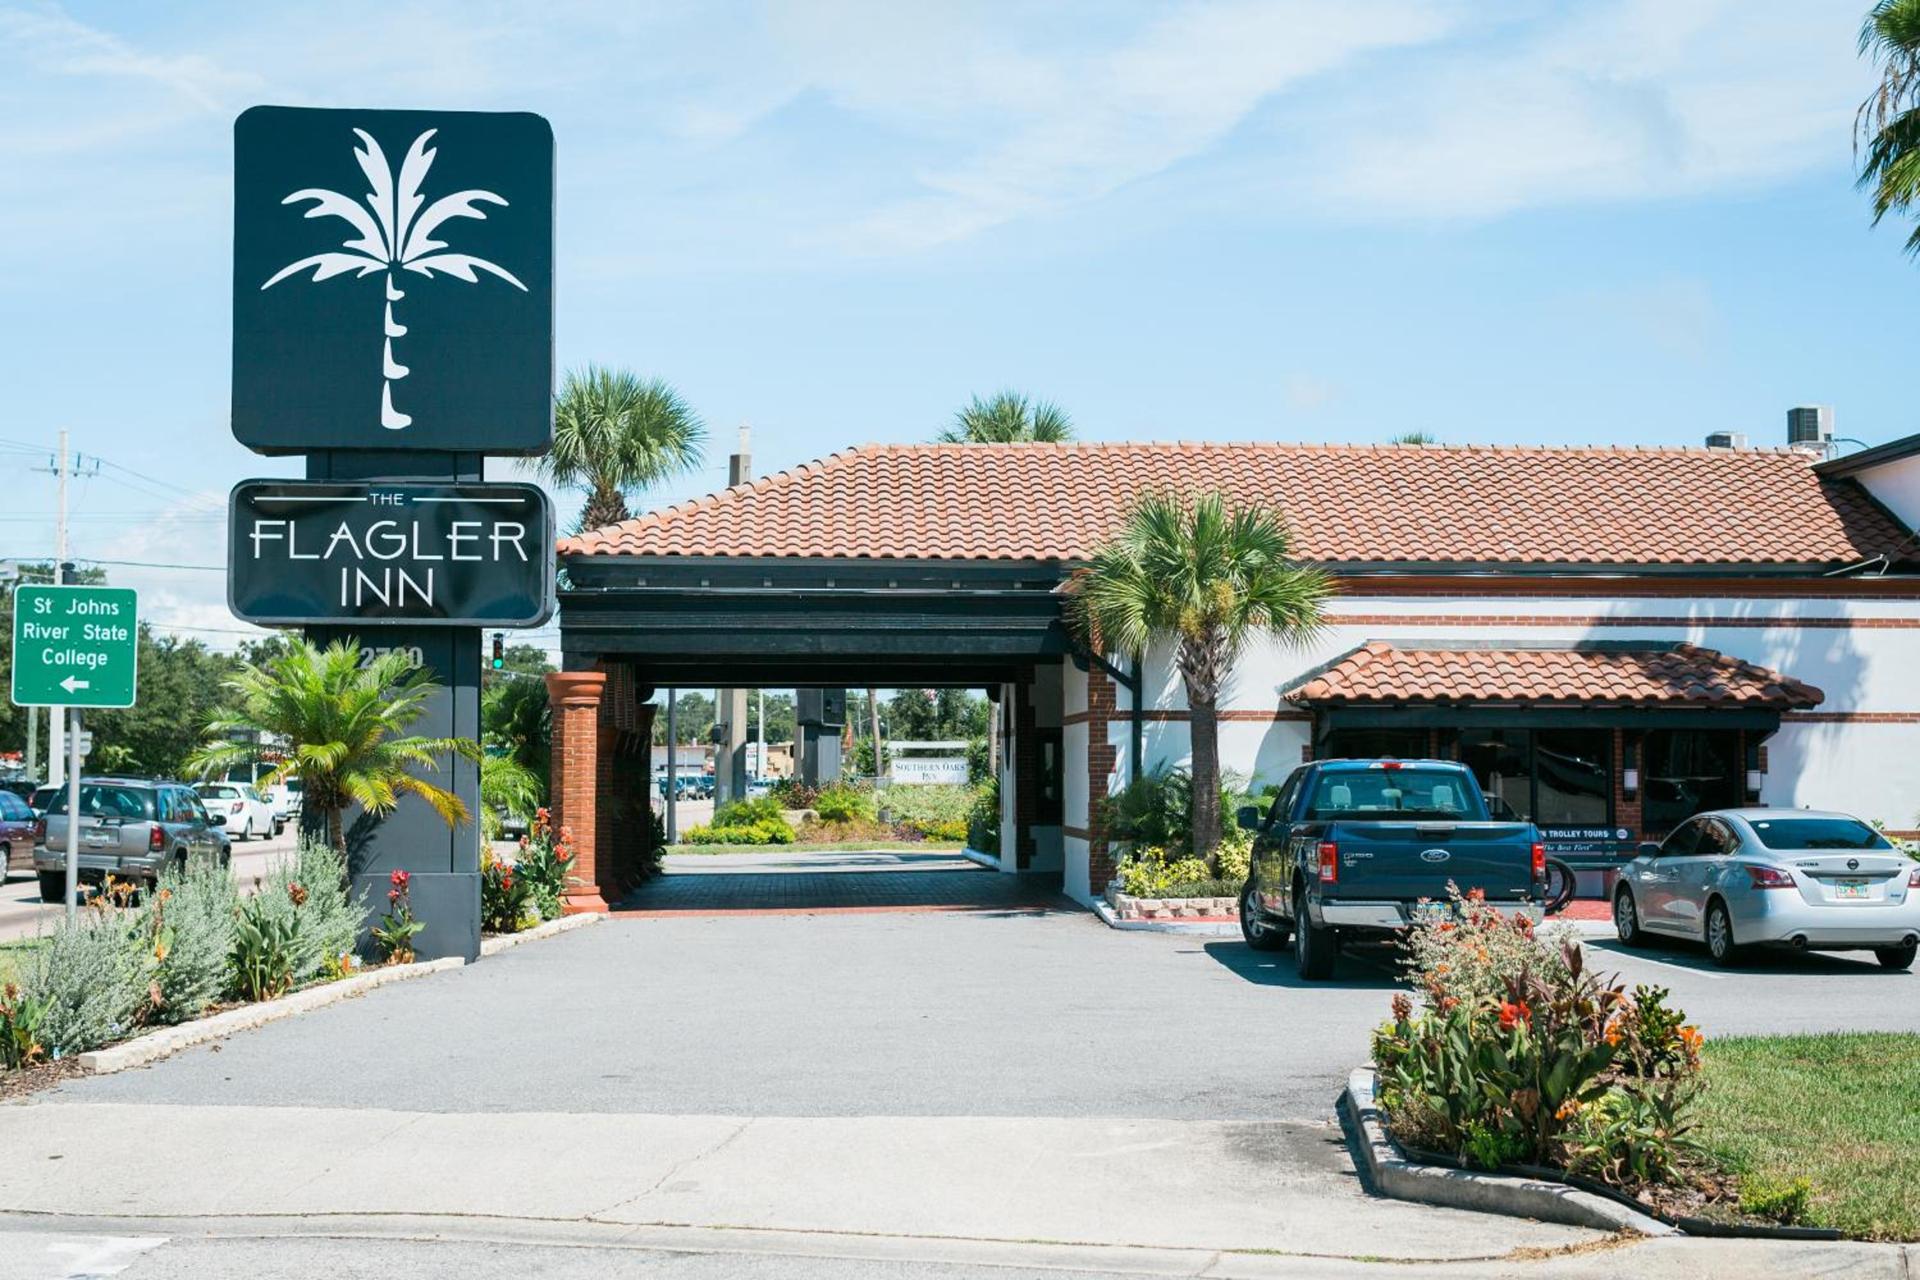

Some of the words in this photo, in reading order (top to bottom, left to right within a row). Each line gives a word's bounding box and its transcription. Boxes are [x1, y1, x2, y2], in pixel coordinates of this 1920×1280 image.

[369, 493, 404, 506] THE
[249, 520, 529, 562] FLAGLER
[341, 567, 434, 608] INN
[34, 597, 53, 614] St
[65, 598, 120, 615] Johns
[23, 622, 69, 640] River
[83, 624, 128, 641] State
[42, 648, 108, 670] College
[1549, 829, 1581, 839] TROLLEY
[1583, 829, 1609, 839] TOURS
